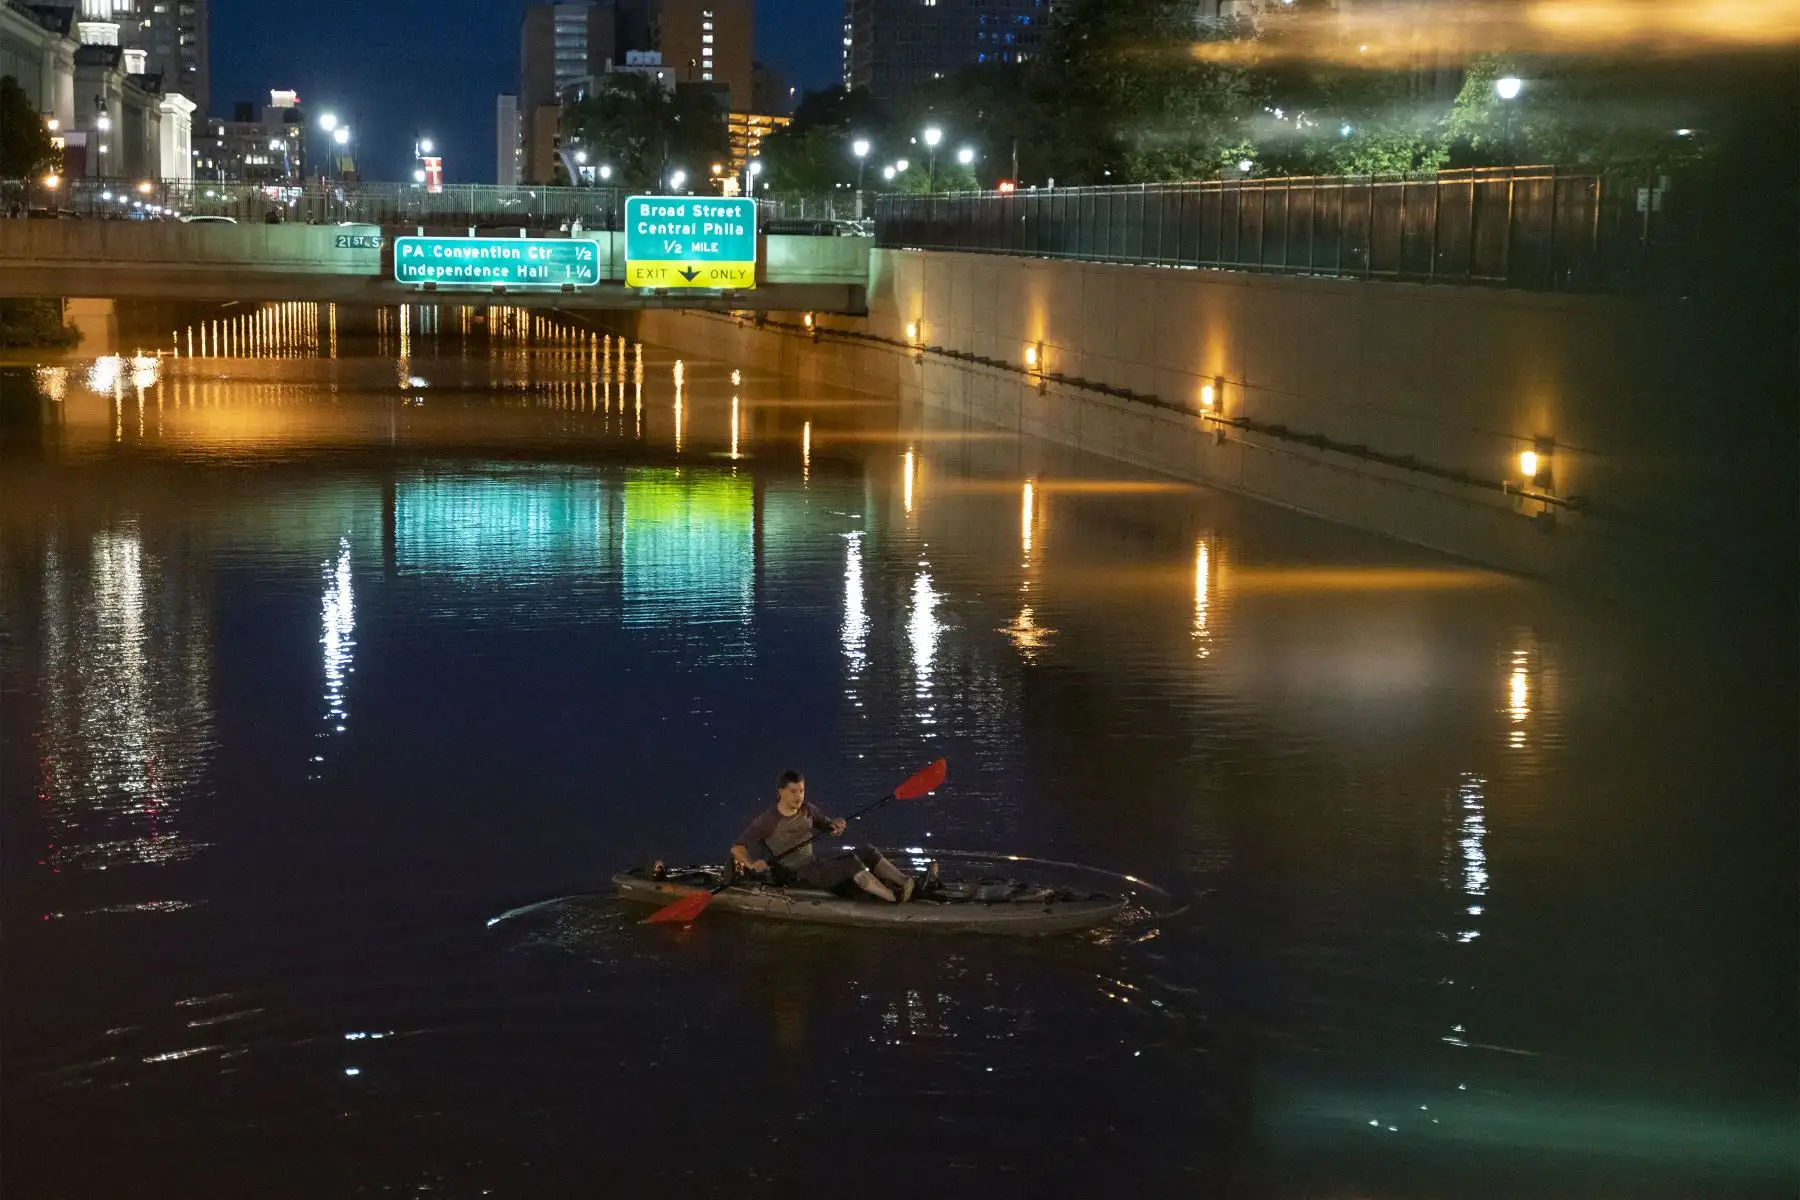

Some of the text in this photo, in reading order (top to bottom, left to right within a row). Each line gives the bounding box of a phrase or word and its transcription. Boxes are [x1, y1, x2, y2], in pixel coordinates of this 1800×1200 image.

[640, 203, 742, 218] Broad Street
[637, 221, 744, 236] Central Phila
[402, 245, 424, 257] PA
[433, 244, 521, 259] Convention
[528, 246, 553, 260] Ctr
[691, 242, 719, 253] MILE
[402, 263, 510, 279] Independence
[517, 265, 549, 278] Hall
[636, 268, 746, 280] EXIT ONLY
